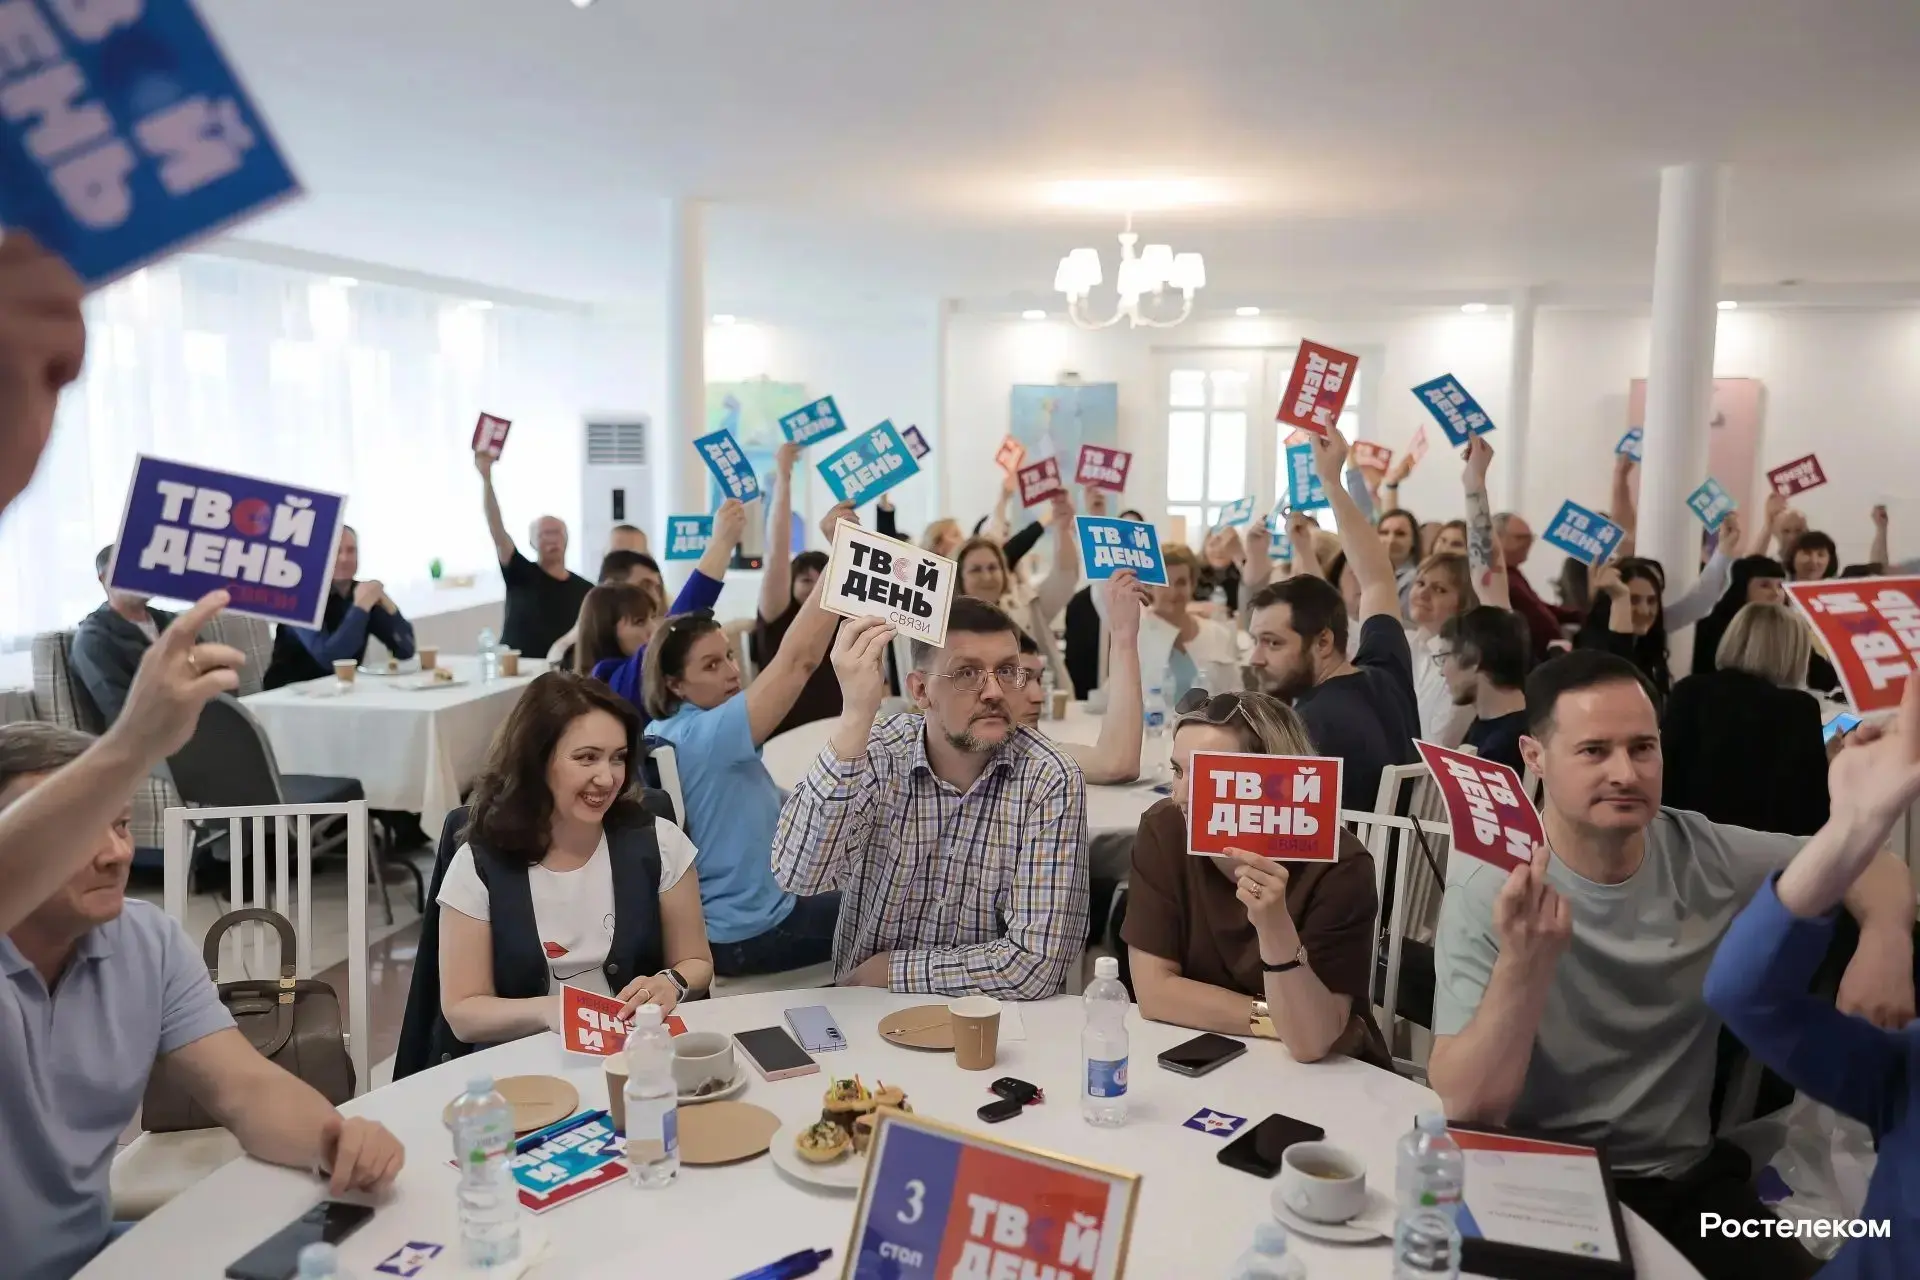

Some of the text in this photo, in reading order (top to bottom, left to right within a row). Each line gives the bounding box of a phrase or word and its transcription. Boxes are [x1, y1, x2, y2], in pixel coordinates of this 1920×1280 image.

[1293, 351, 1329, 418] ДЕНЬ
[703, 443, 743, 498] ДЕНЬ
[841, 452, 904, 499] ДЕНЬ
[138, 524, 303, 588] ДЕНЬ
[1093, 546, 1155, 569] ДЕНЬ
[840, 569, 933, 618] ДЕНЬ
[889, 611, 931, 634] СВЯЗИ
[1207, 802, 1319, 837] ДЕНЬ
[1440, 756, 1501, 846] ДЕНЬ
[896, 1179, 926, 1224] 3
